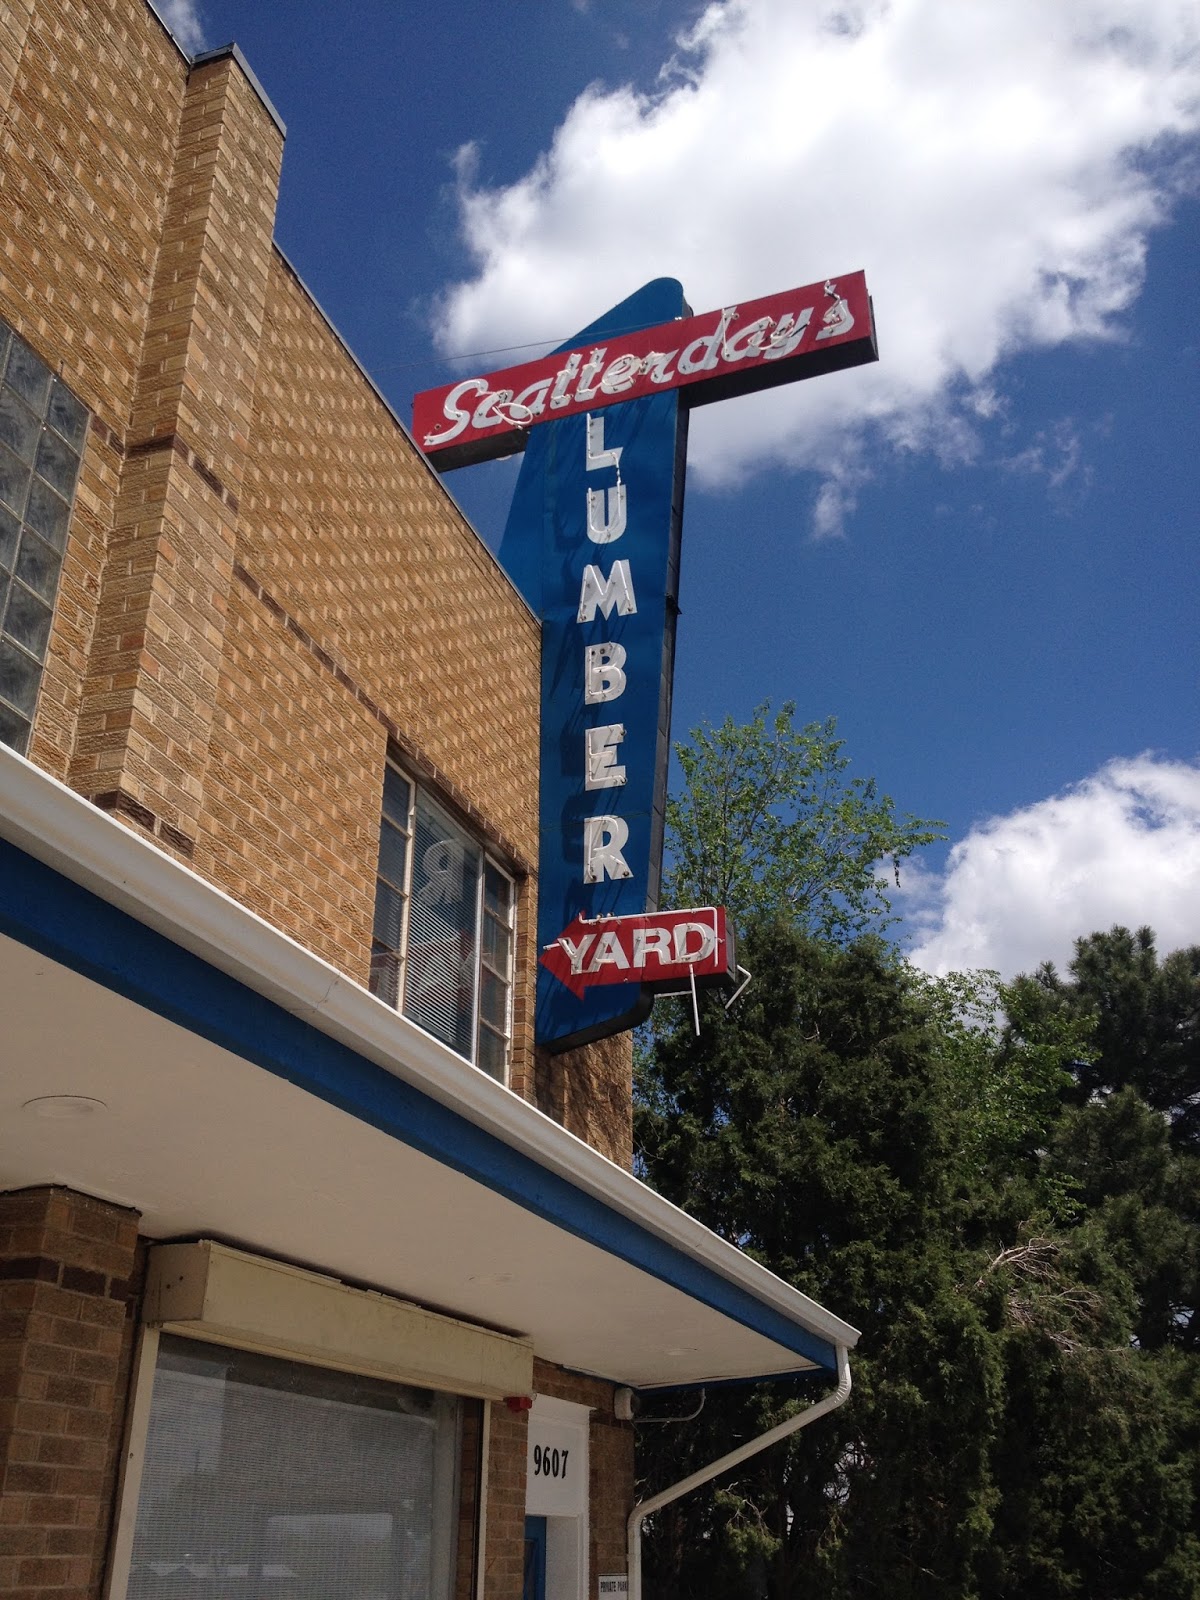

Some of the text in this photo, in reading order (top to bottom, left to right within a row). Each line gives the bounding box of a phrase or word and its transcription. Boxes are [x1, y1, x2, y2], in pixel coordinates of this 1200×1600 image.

[423, 280, 855, 446] Scatterday's
[576, 412, 638, 885] LUMBER
[557, 922, 716, 976] YARD
[533, 1444, 569, 1479] 9607
